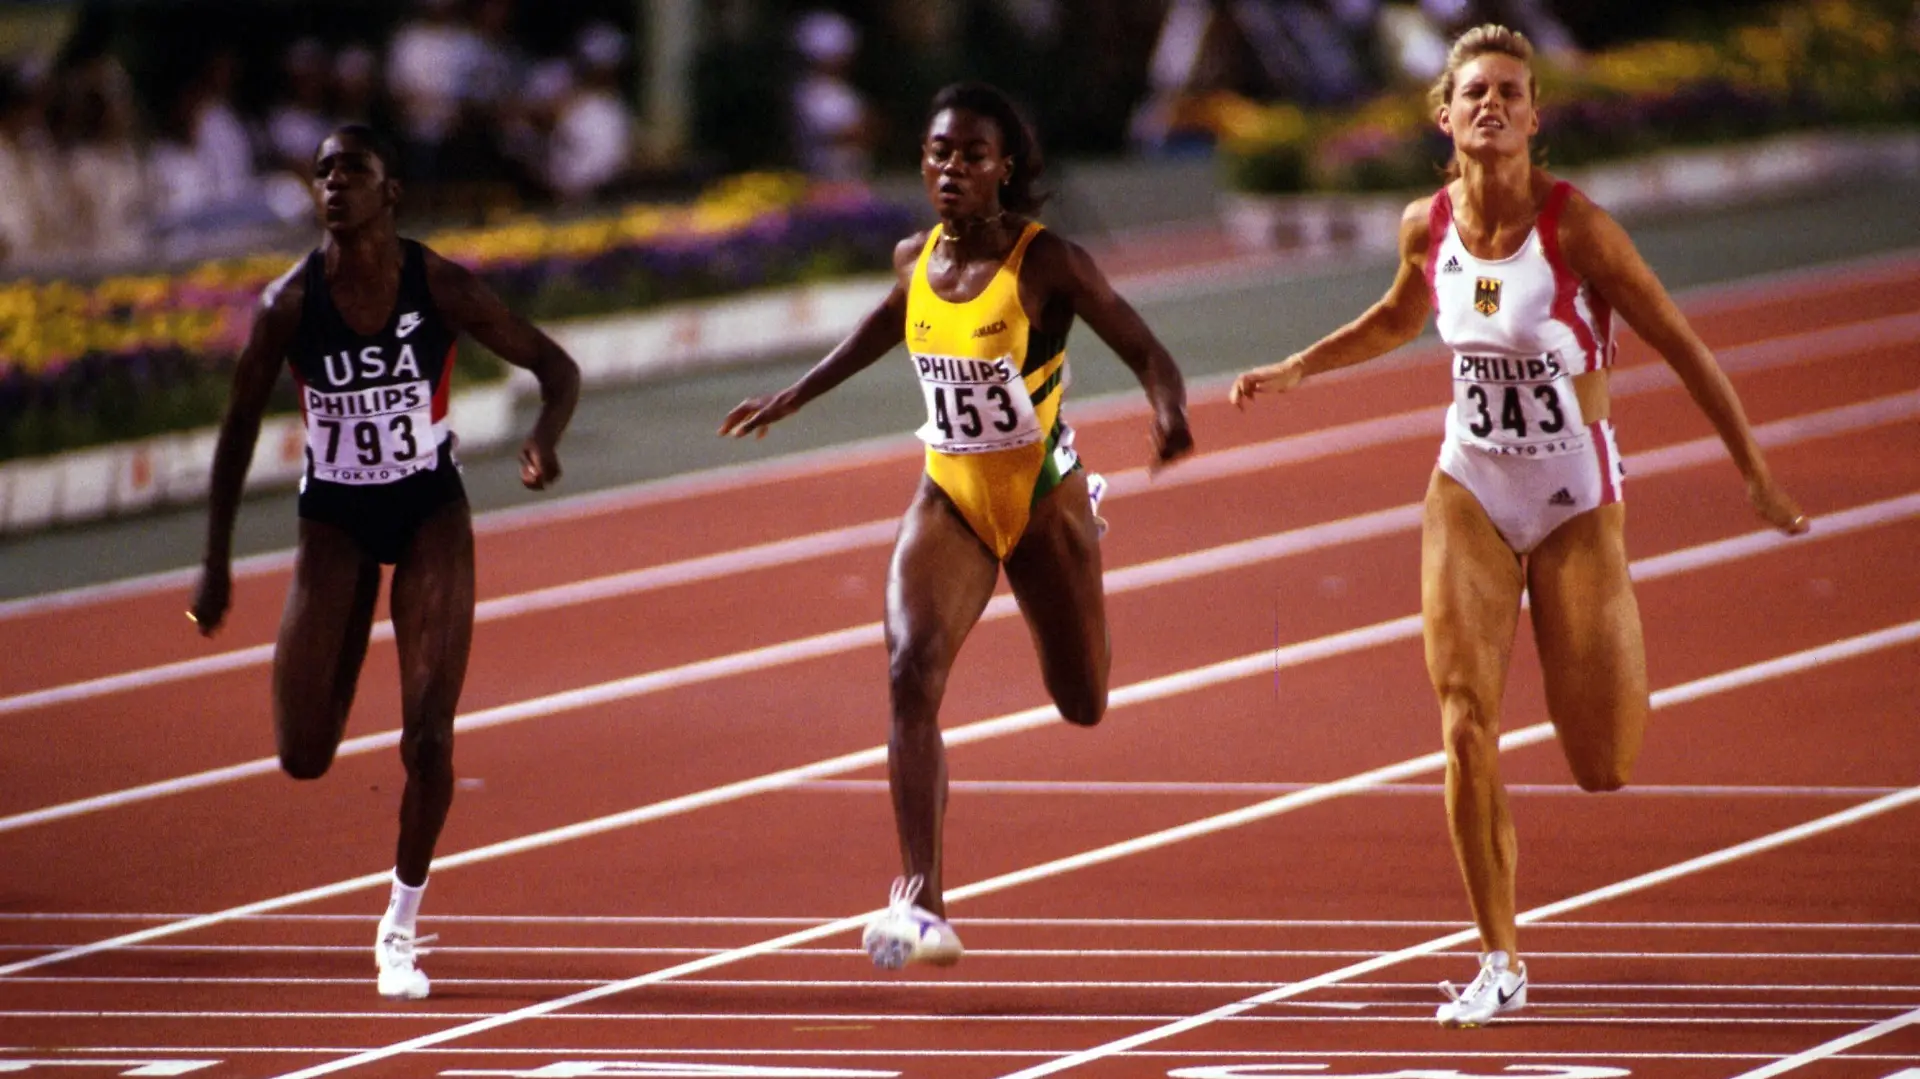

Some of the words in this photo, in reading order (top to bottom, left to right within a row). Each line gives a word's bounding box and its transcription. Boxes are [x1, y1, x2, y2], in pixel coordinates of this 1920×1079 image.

[323, 343, 421, 386] USA
[918, 356, 1010, 382] PHILIPS
[1460, 352, 1561, 381] PHILIPS
[309, 385, 420, 417] PHILIPS
[934, 385, 1018, 439] 453
[1466, 384, 1565, 438] 343
[317, 414, 417, 466] 793
[1488, 444, 1537, 456] OKYO
[331, 469, 390, 480] TOKYO
